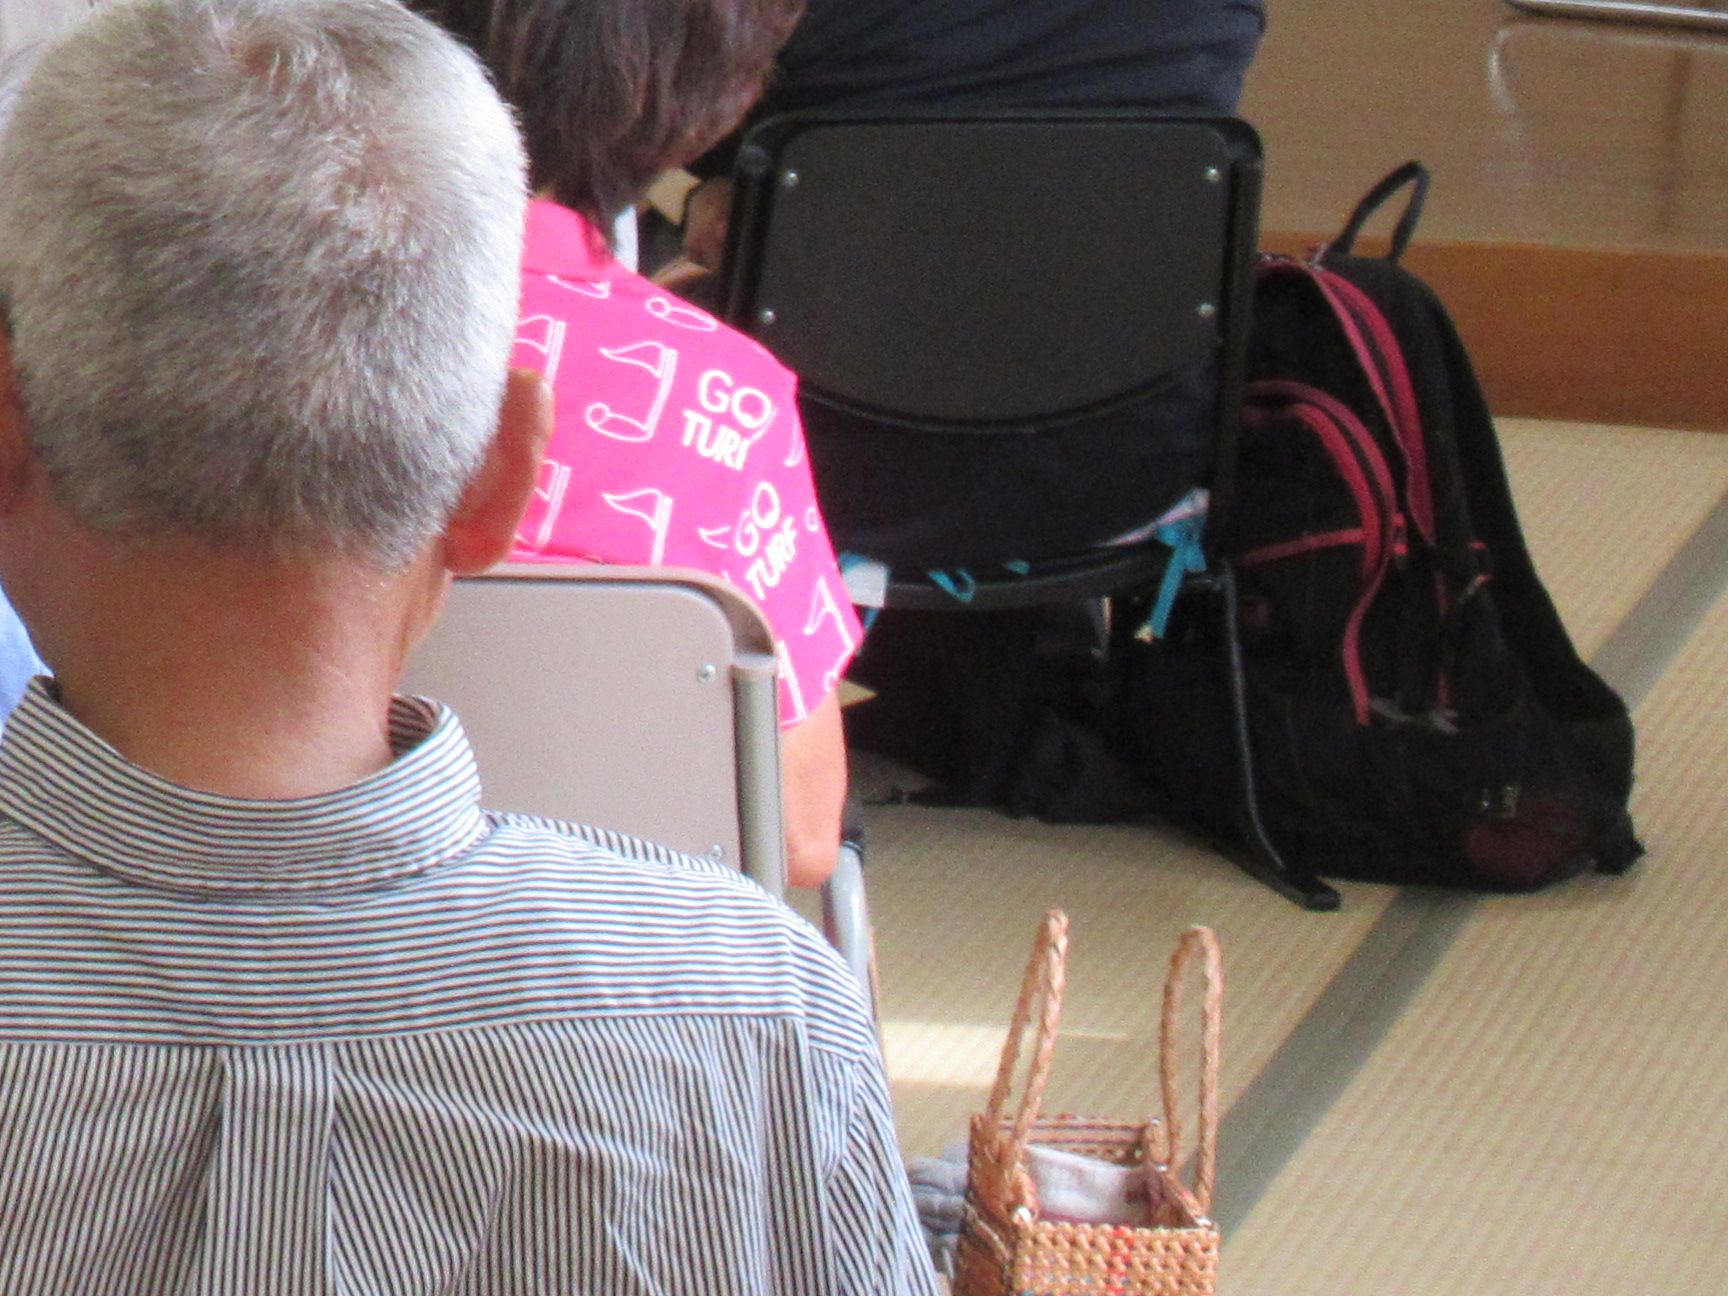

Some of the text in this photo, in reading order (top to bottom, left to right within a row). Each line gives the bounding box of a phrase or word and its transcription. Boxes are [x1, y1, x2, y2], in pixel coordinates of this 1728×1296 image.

[698, 369, 772, 428] GO
[735, 481, 780, 557] GO
[745, 516, 797, 601] TURF
